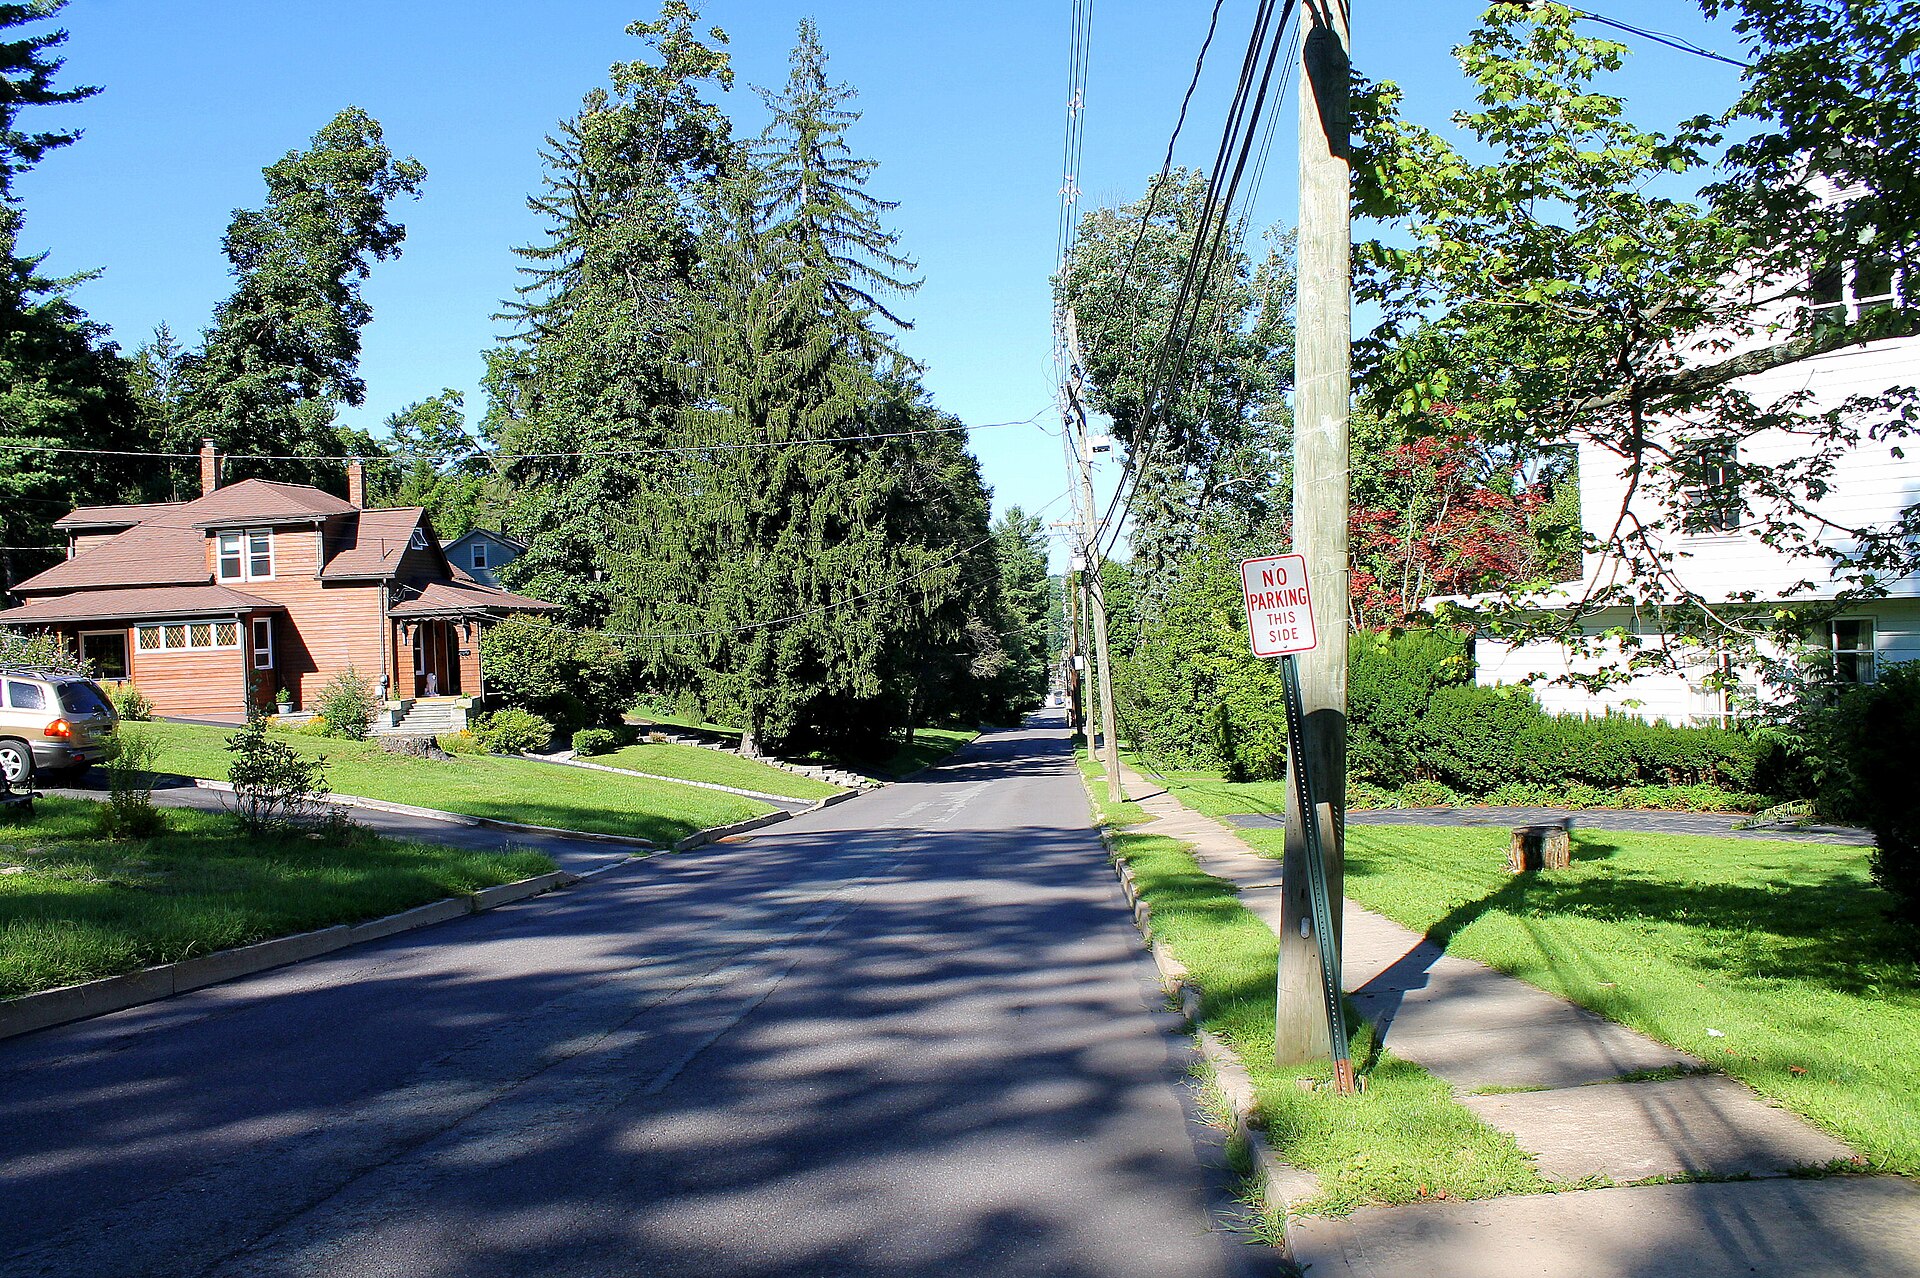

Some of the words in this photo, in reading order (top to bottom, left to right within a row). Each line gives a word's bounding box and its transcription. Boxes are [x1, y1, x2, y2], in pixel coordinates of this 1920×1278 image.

[1262, 568, 1287, 587] NO
[1250, 587, 1307, 611] PARKING
[1267, 611, 1295, 625] THIS
[1269, 628, 1298, 642] SIDE
